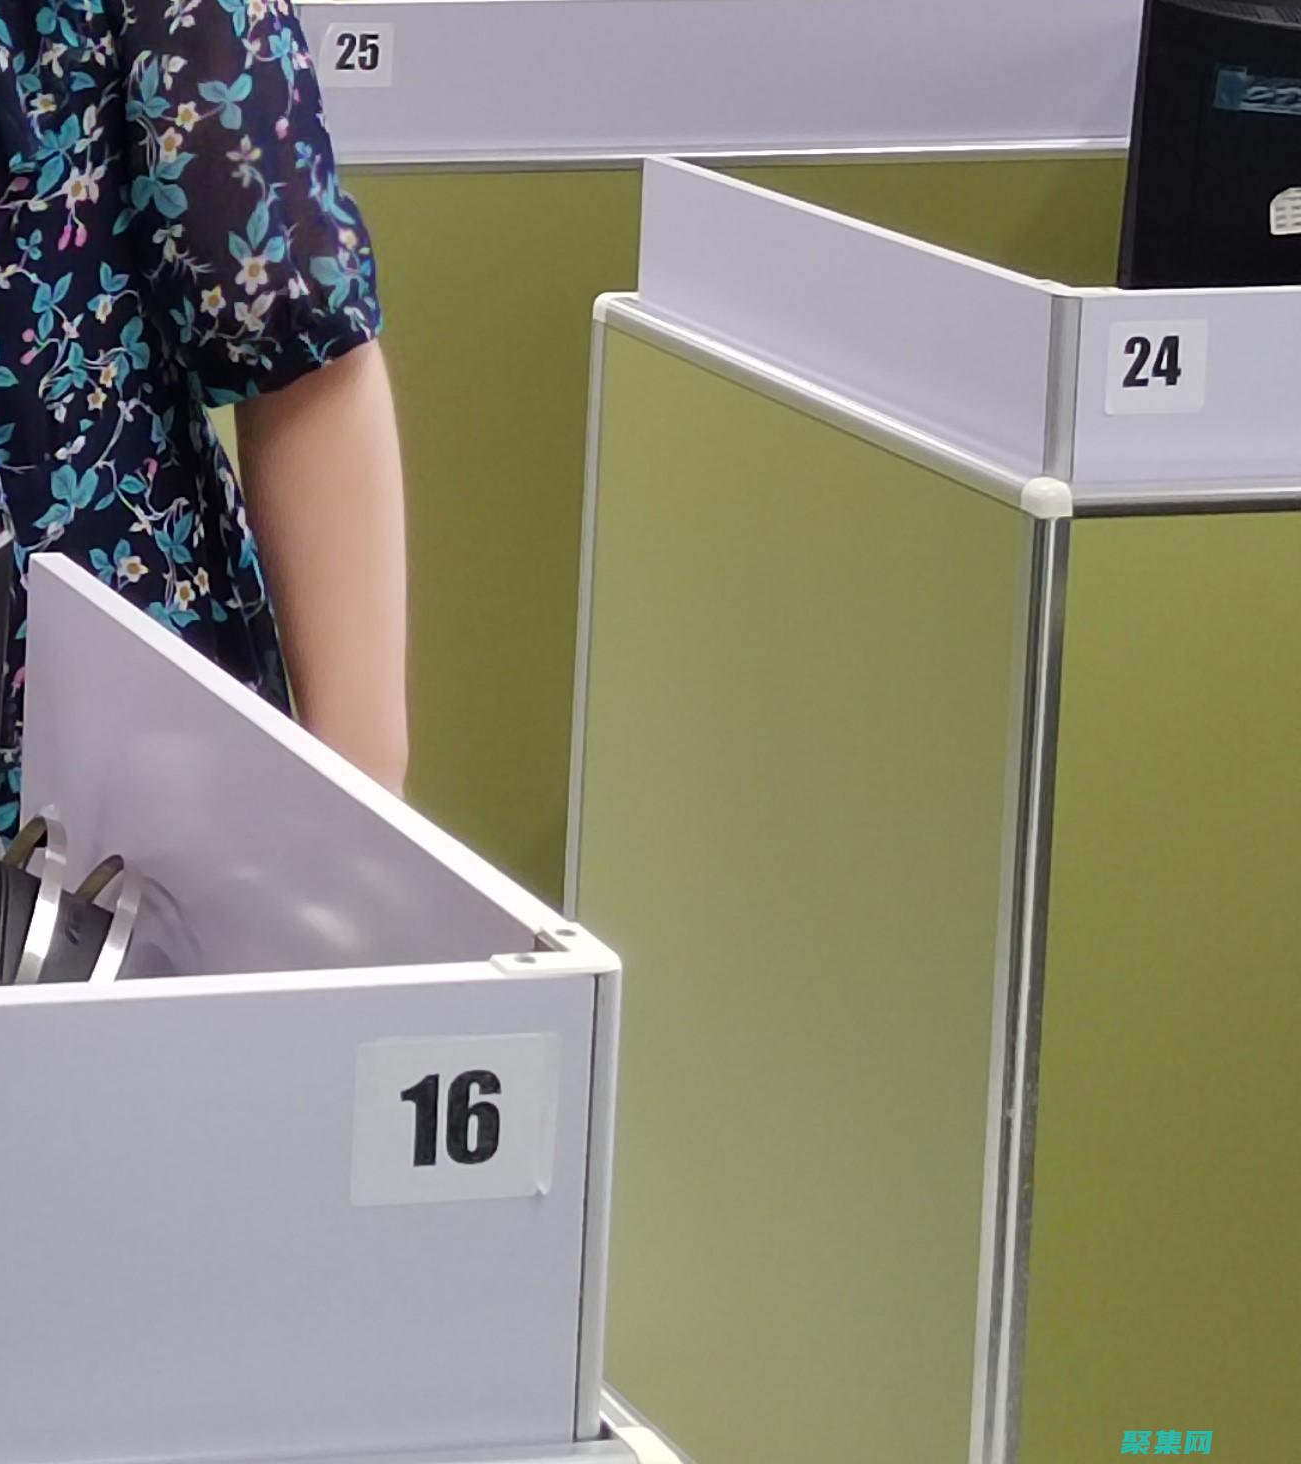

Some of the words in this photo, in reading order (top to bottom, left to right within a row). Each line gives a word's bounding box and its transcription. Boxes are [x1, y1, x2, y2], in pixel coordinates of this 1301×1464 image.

[335, 33, 379, 71] 25
[1122, 335, 1182, 387] 24
[399, 1069, 502, 1168] 16
